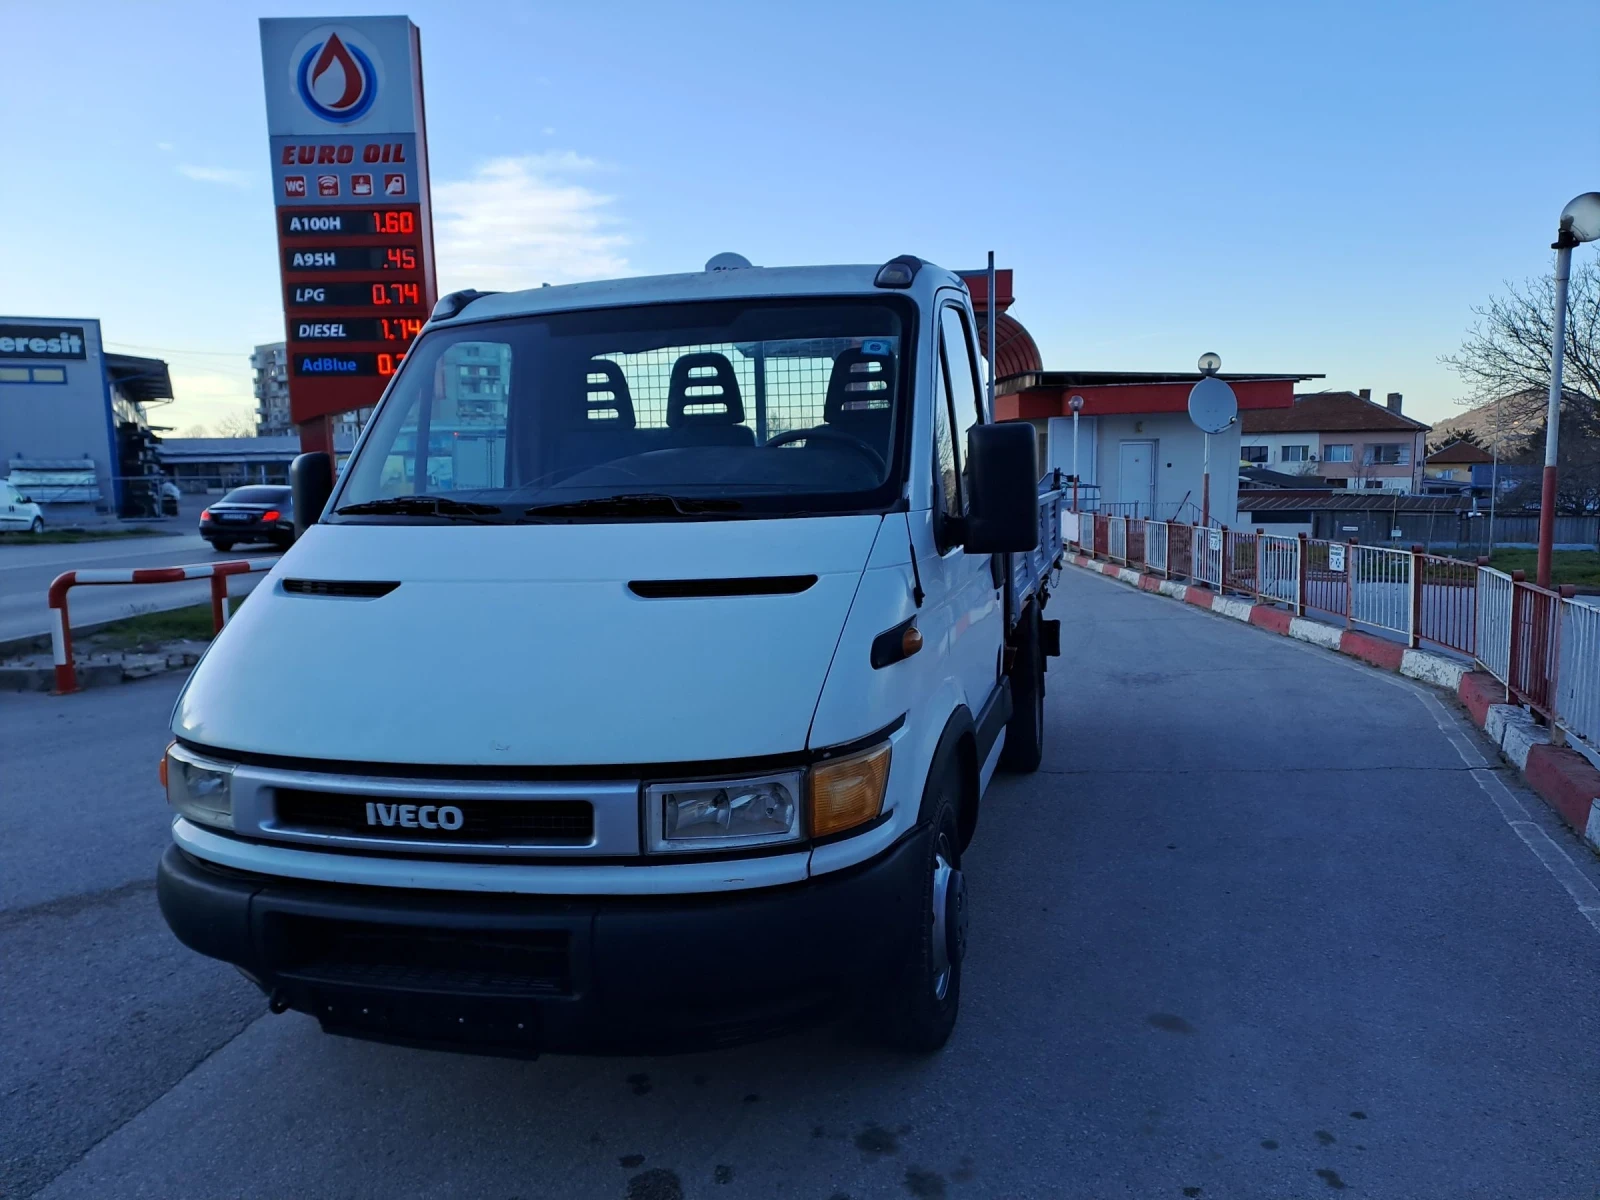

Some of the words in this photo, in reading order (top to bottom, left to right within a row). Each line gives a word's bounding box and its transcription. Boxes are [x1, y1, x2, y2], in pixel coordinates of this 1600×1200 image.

[282, 145, 353, 165] EURO
[363, 144, 406, 163] OIL
[286, 180, 304, 193] WC
[290, 216, 341, 231] A100H
[373, 211, 414, 233] 1.60
[293, 252, 336, 267] A95H
[296, 288, 325, 302] LPG
[372, 283, 419, 304] 0.74
[299, 323, 346, 338] DIESEL
[302, 358, 357, 371] AdBlue
[365, 802, 464, 830] IVECO
